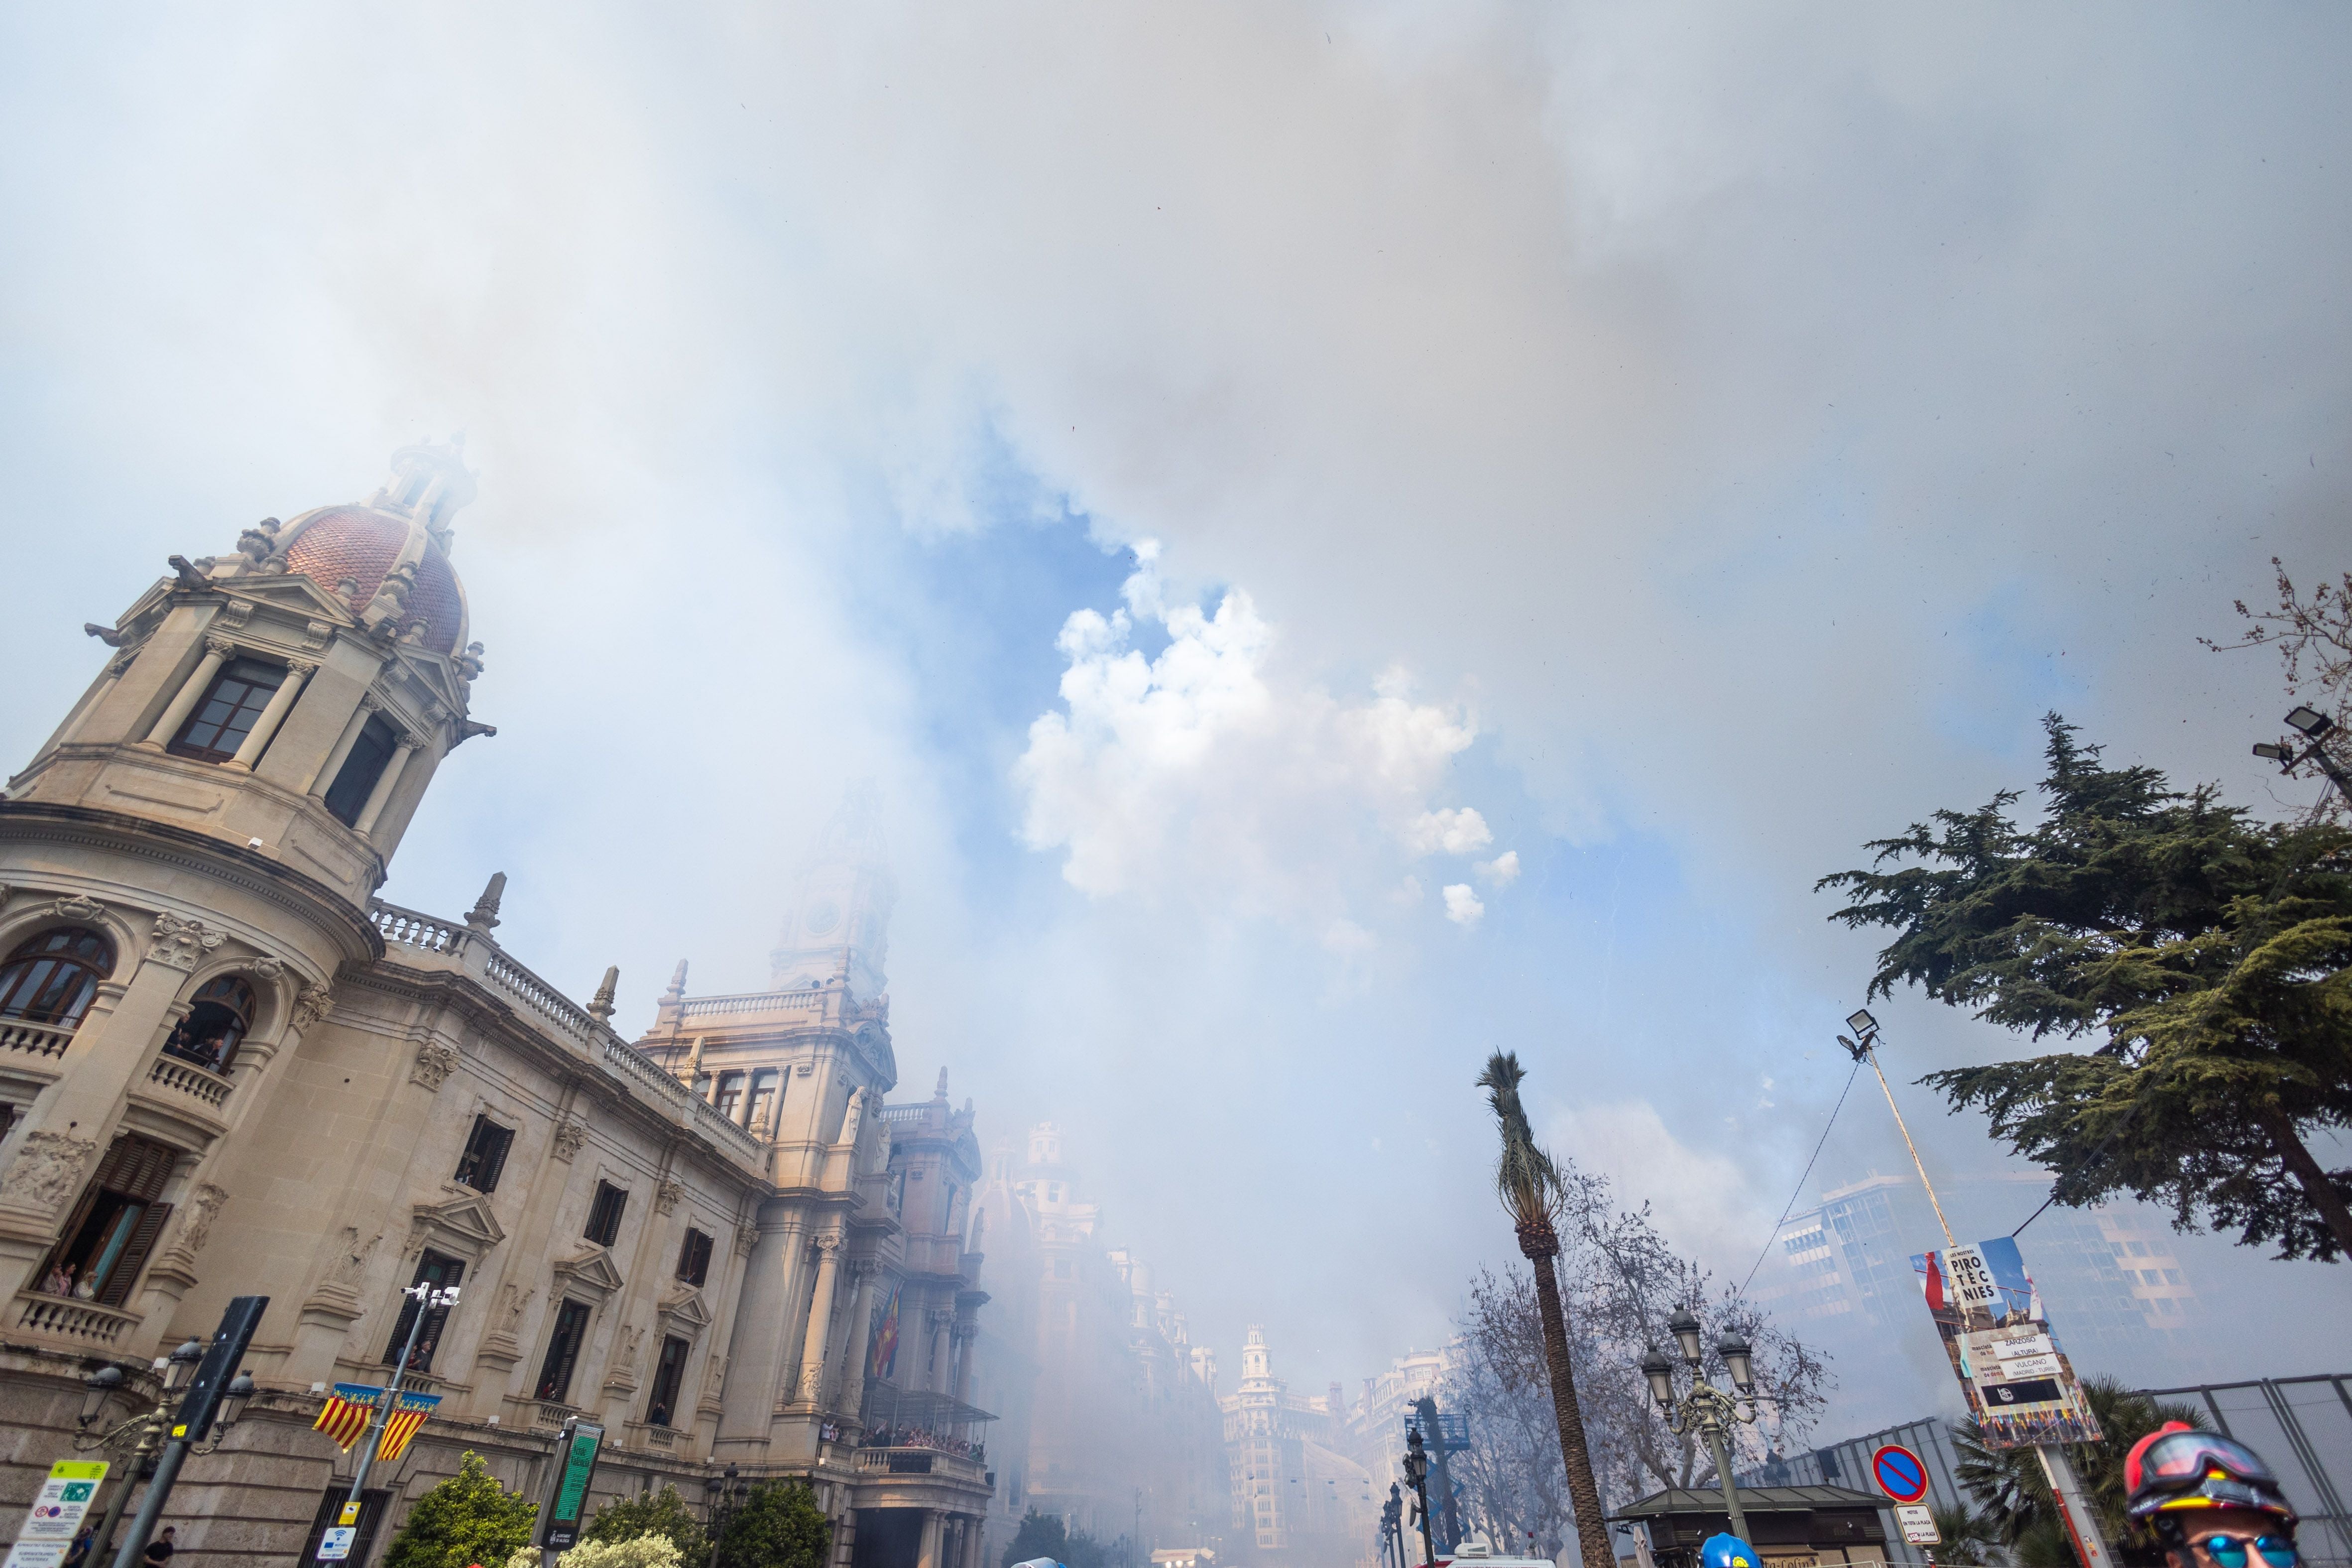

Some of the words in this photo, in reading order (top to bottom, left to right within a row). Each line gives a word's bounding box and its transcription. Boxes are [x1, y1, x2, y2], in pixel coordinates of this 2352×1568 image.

[1951, 1256, 1981, 1272] PIRO
[1963, 1285, 1994, 1301] NIES
[2004, 1336, 2036, 1346] ZARZOSO
[2014, 1358, 2046, 1368] VULCANO
